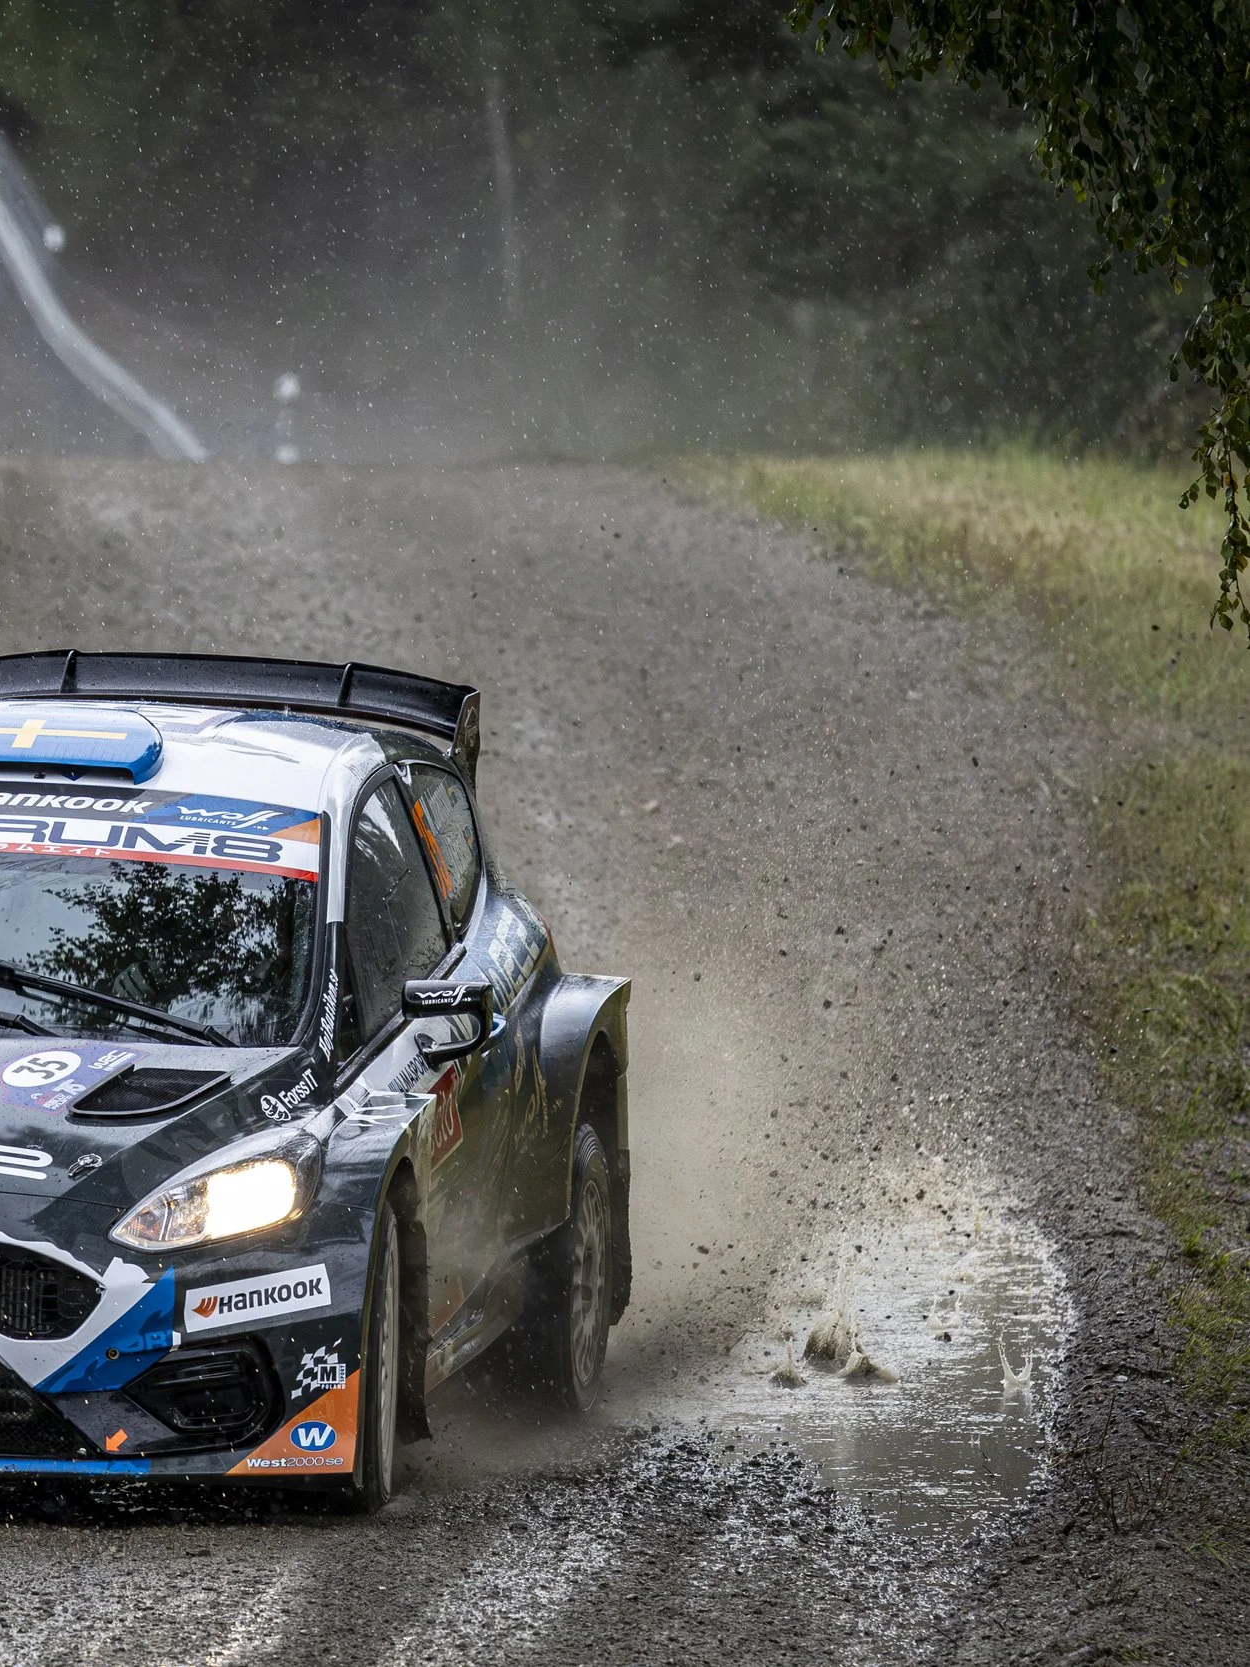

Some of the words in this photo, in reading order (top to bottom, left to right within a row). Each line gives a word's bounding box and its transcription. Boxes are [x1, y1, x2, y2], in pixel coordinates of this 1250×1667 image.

[180, 815, 236, 826] LUBRICANTS
[12, 1058, 68, 1080] 35
[319, 1366, 336, 1382] M
[298, 1424, 333, 1447] W
[247, 1456, 344, 1468] West2000.se
